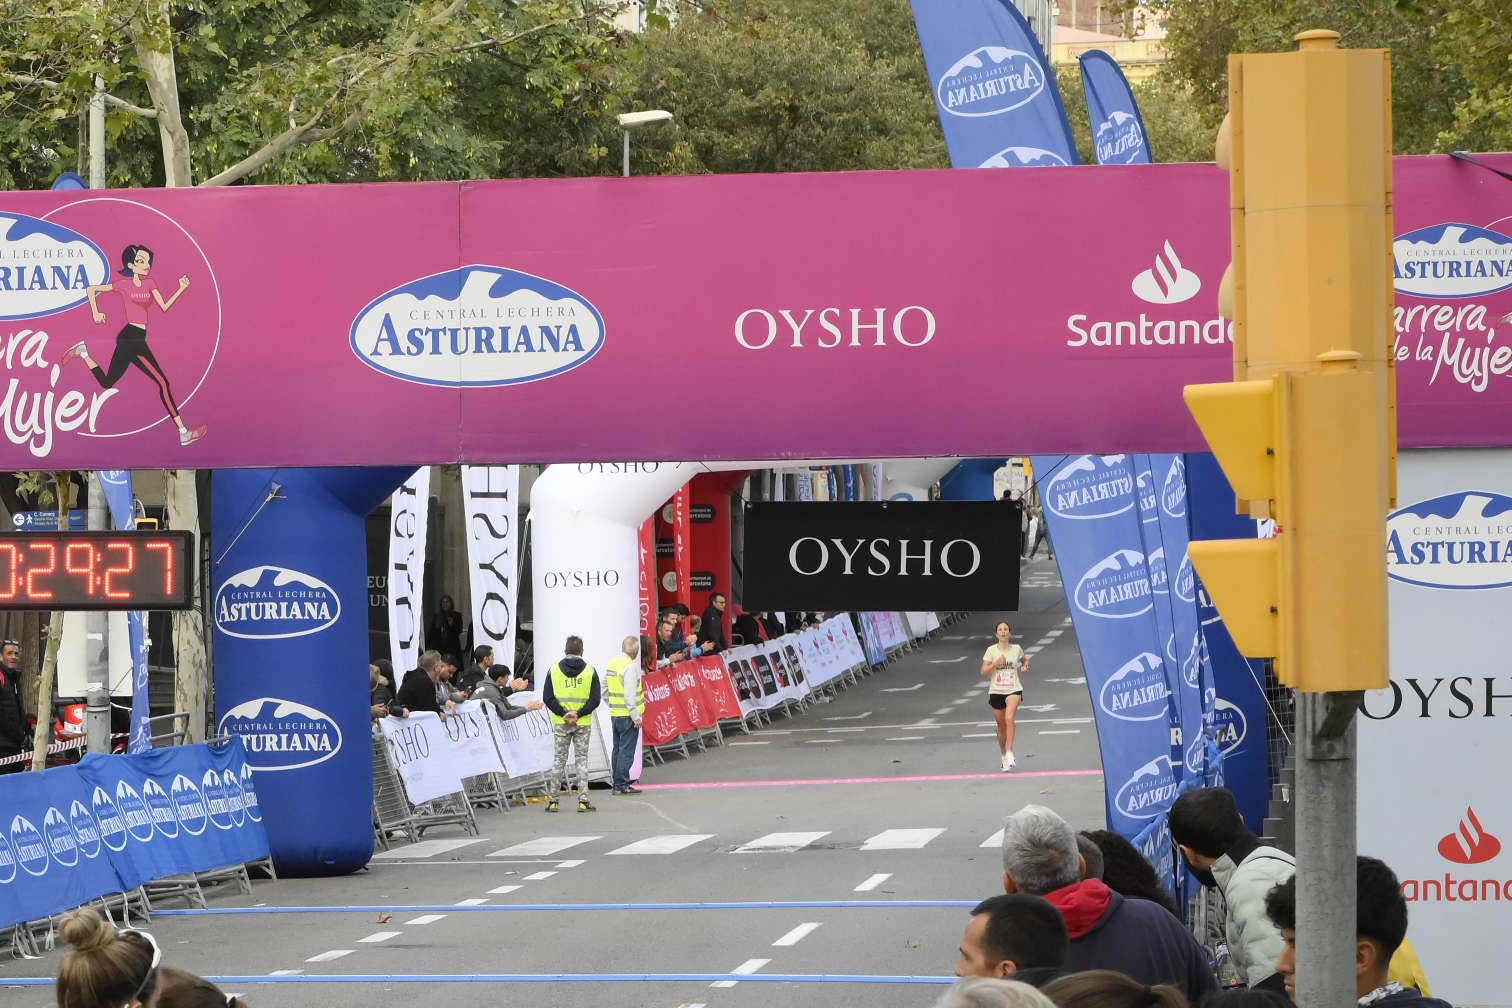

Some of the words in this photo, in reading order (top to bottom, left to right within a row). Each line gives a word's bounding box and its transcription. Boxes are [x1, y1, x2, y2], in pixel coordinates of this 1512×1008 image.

[13, 248, 85, 259] LECHERA
[1406, 249, 1457, 257] CENTRAL
[409, 308, 487, 321] CENTRAL
[496, 306, 576, 318] LECHERA
[1393, 304, 1487, 333] arrera
[370, 312, 586, 357] ASTURIANA
[734, 305, 937, 350] OYSHO
[1414, 333, 1433, 361] la
[1429, 328, 1512, 393] Muje
[1413, 526, 1480, 536] CENTRAL
[788, 537, 981, 577] OYSHO
[544, 569, 620, 589] OYSHO
[231, 591, 274, 599] CENTRAL
[278, 591, 326, 599] LECHERA
[219, 596, 332, 623] ASTURIANA
[233, 723, 274, 731] CENTRAL
[278, 722, 326, 730] LECHERA
